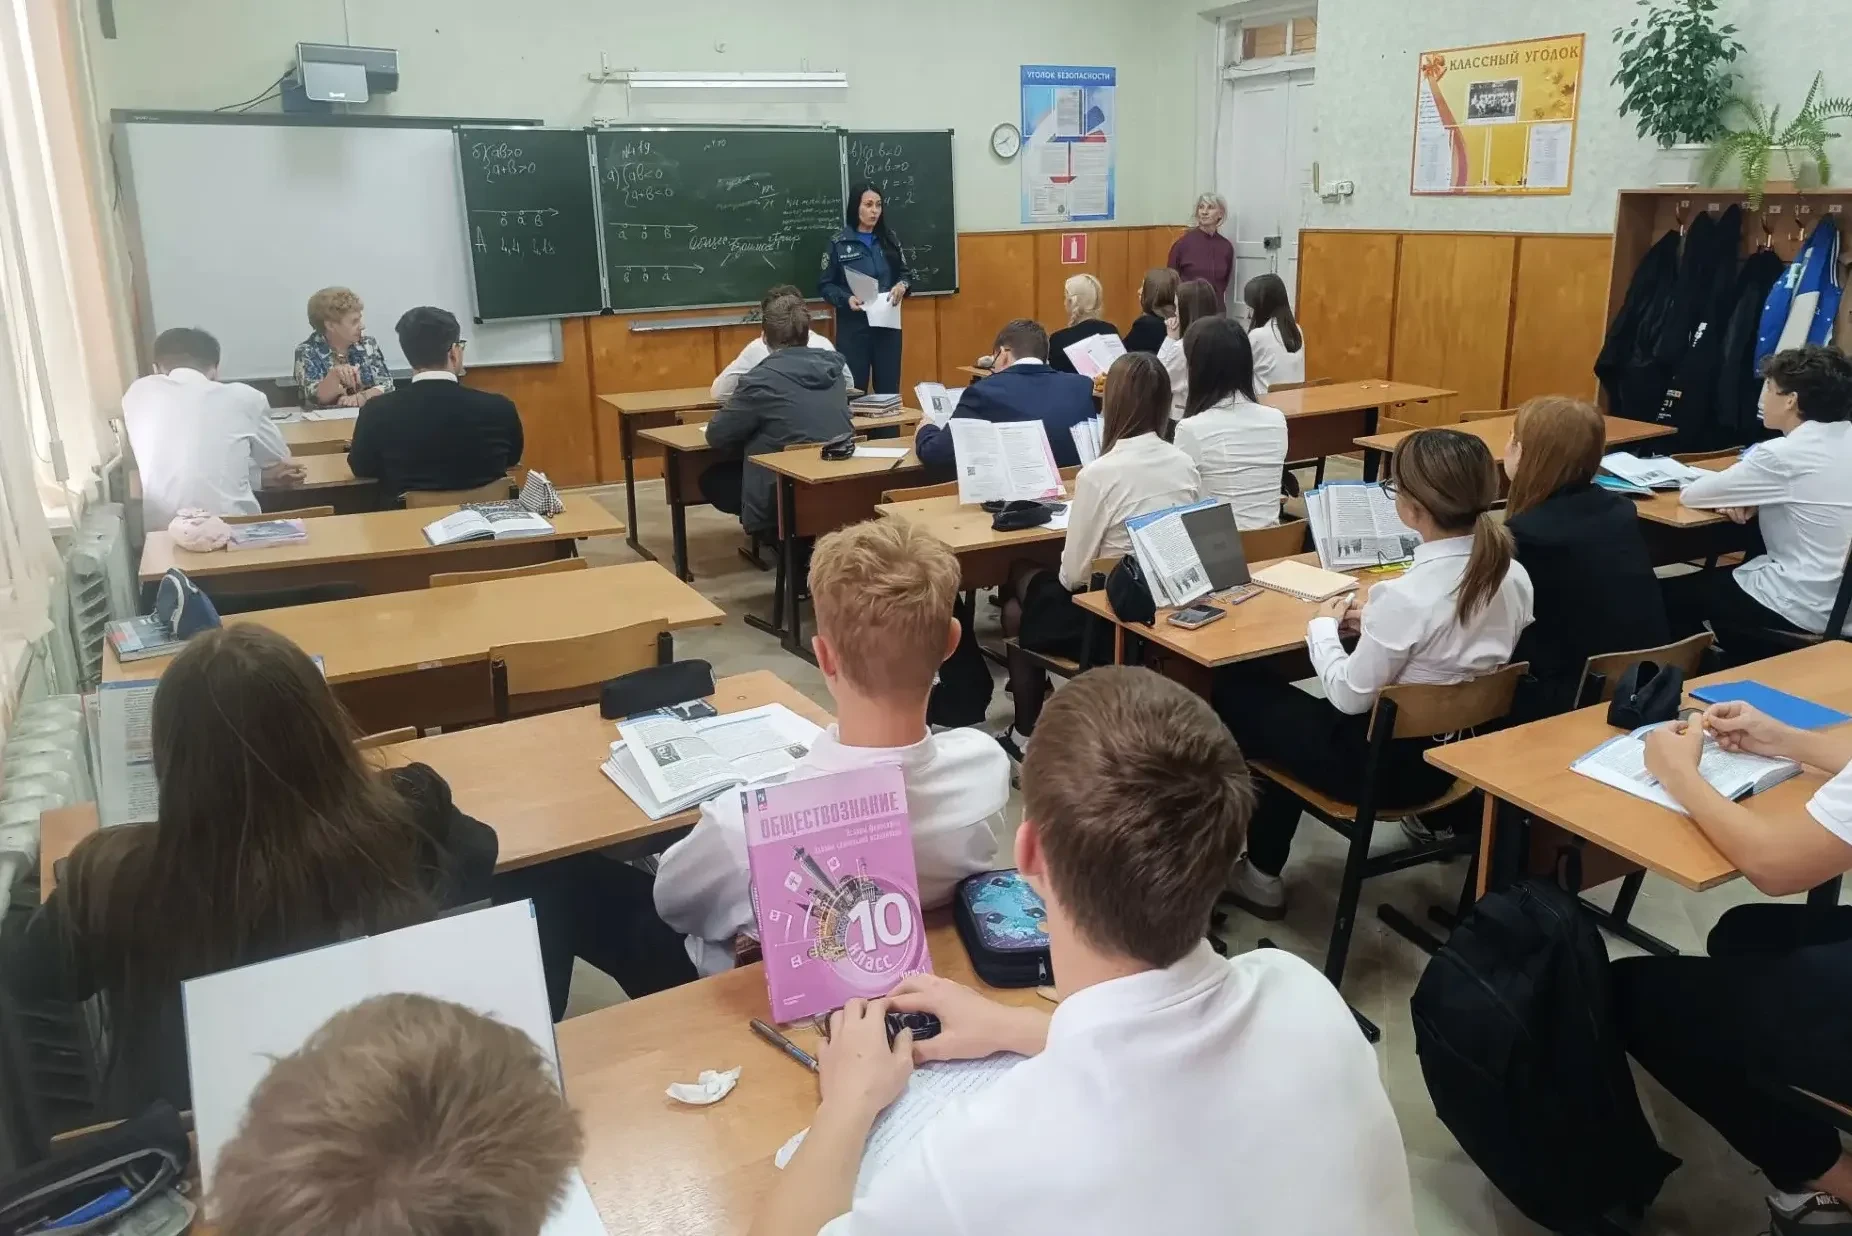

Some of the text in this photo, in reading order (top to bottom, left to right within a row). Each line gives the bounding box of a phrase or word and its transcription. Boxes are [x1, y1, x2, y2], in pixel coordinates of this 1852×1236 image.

[1449, 45, 1579, 71] КЛАССНЫЙ УГОЛОК
[1027, 71, 1110, 81] УГОЛОК БЕЗОПАСНОСТИ
[760, 791, 899, 839] ОБЩЕСТВОЗНАНИЕ
[848, 892, 912, 951] 10
[1815, 1195, 1840, 1206] NIKE
